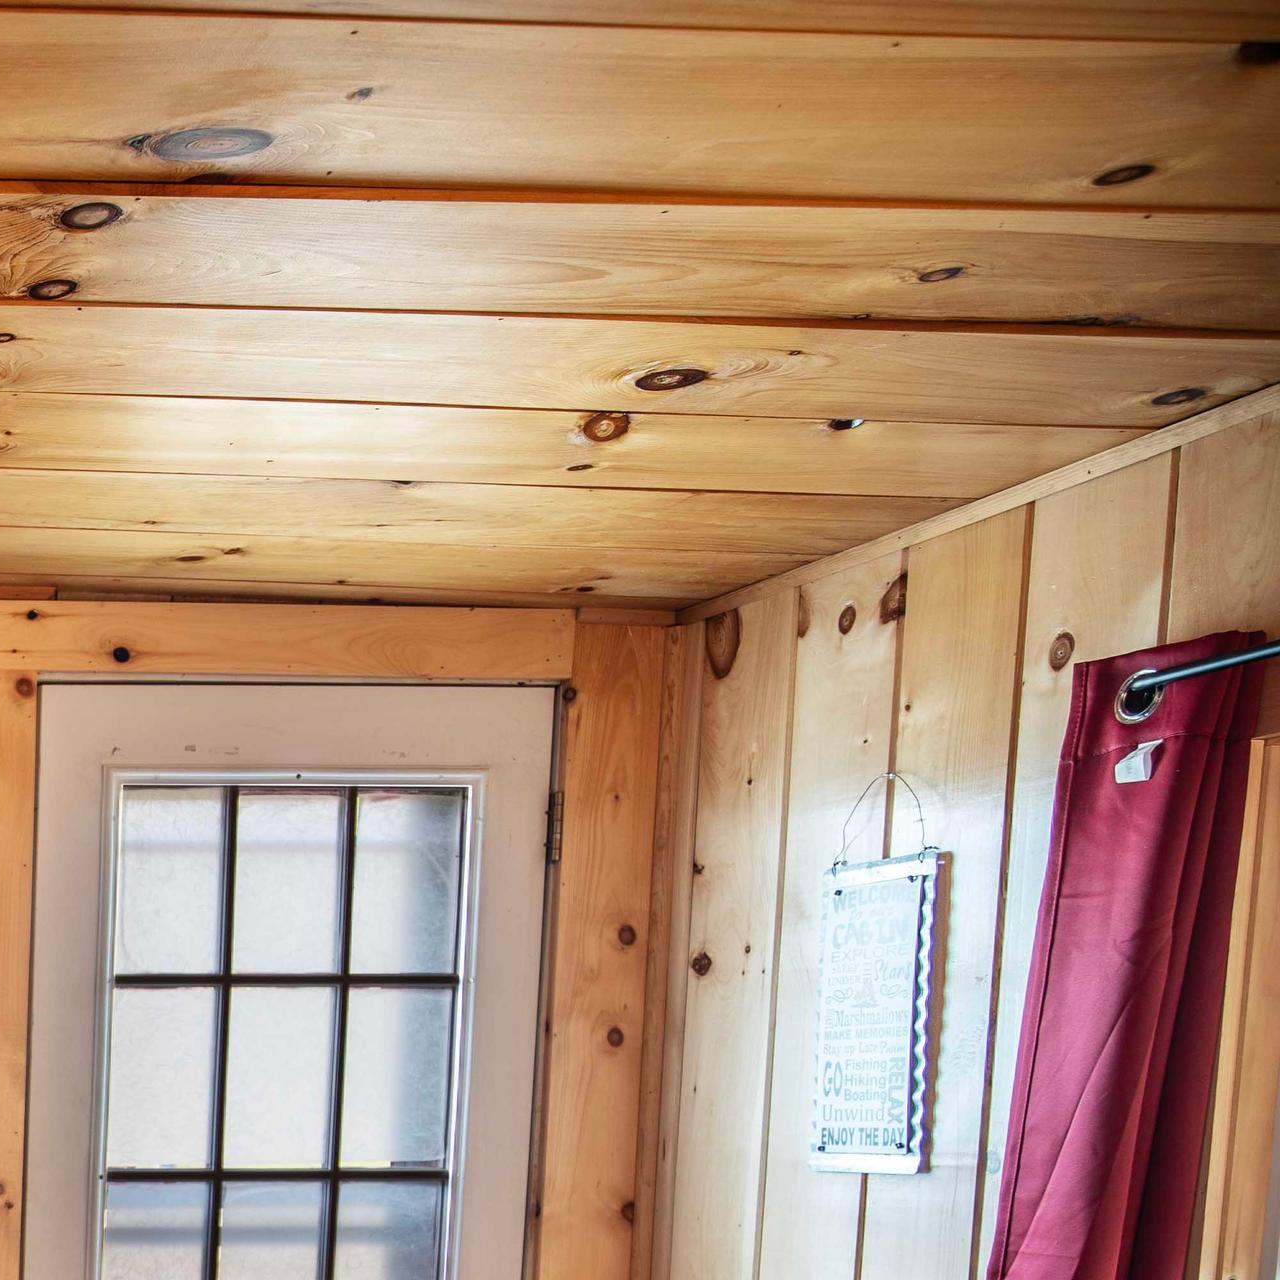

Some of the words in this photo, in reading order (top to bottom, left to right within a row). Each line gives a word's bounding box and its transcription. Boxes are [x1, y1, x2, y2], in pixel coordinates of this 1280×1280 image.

[832, 885, 916, 912] WELCOME
[832, 914, 911, 949] CABIN
[832, 944, 909, 963] EXPLORE
[834, 1007, 909, 1028] Marshmallows
[825, 1028, 852, 1040] MAKE
[855, 1025, 908, 1039] MEMORIES
[844, 1058, 888, 1073] Fishing
[823, 1061, 843, 1098] GO
[844, 1073, 887, 1089] Hiking
[844, 1088, 888, 1104] Boating
[887, 1056, 906, 1124] RELAX
[822, 1103, 885, 1122] Unwind
[821, 1127, 855, 1147] ENJOY
[858, 1127, 879, 1146] THE
[883, 1127, 905, 1146] DAY
